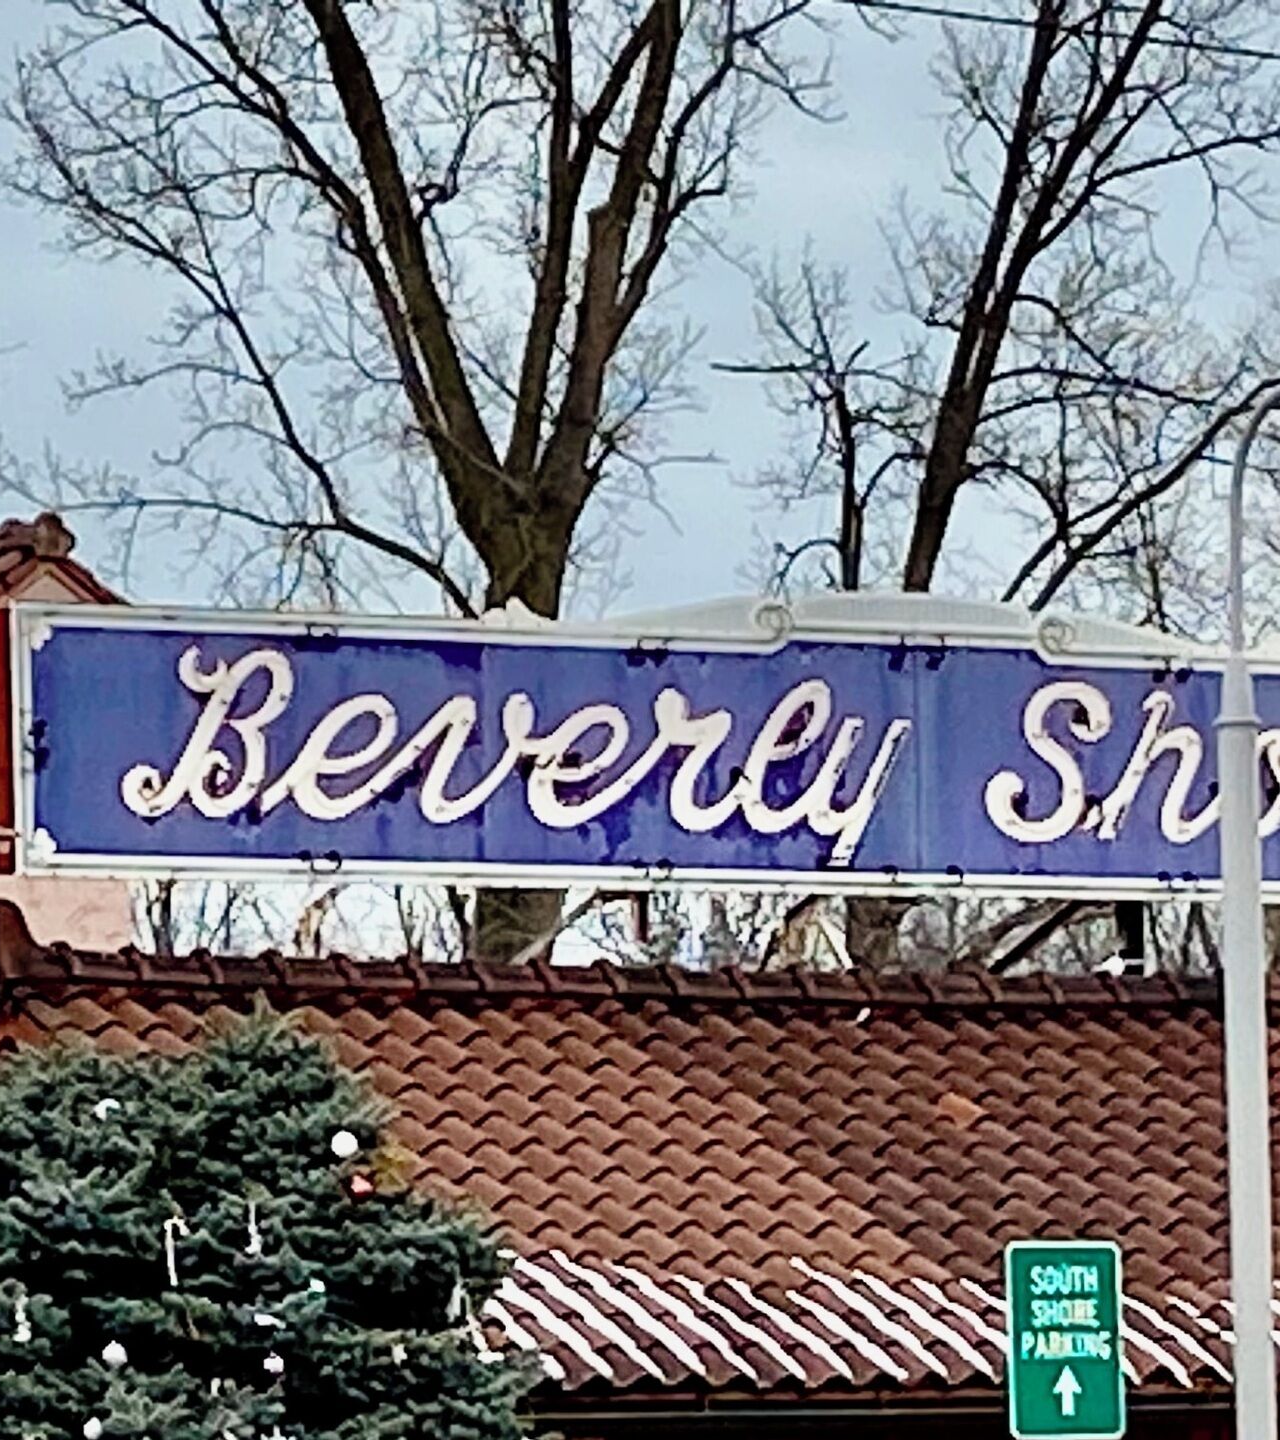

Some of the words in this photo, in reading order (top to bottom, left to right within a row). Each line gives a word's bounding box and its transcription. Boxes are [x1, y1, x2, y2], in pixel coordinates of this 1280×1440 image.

[118, 644, 914, 868] Beverly
[1030, 1264, 1098, 1295] SOUTH
[1030, 1298, 1100, 1328] SHORE
[1021, 1330, 1112, 1360] PARKING
